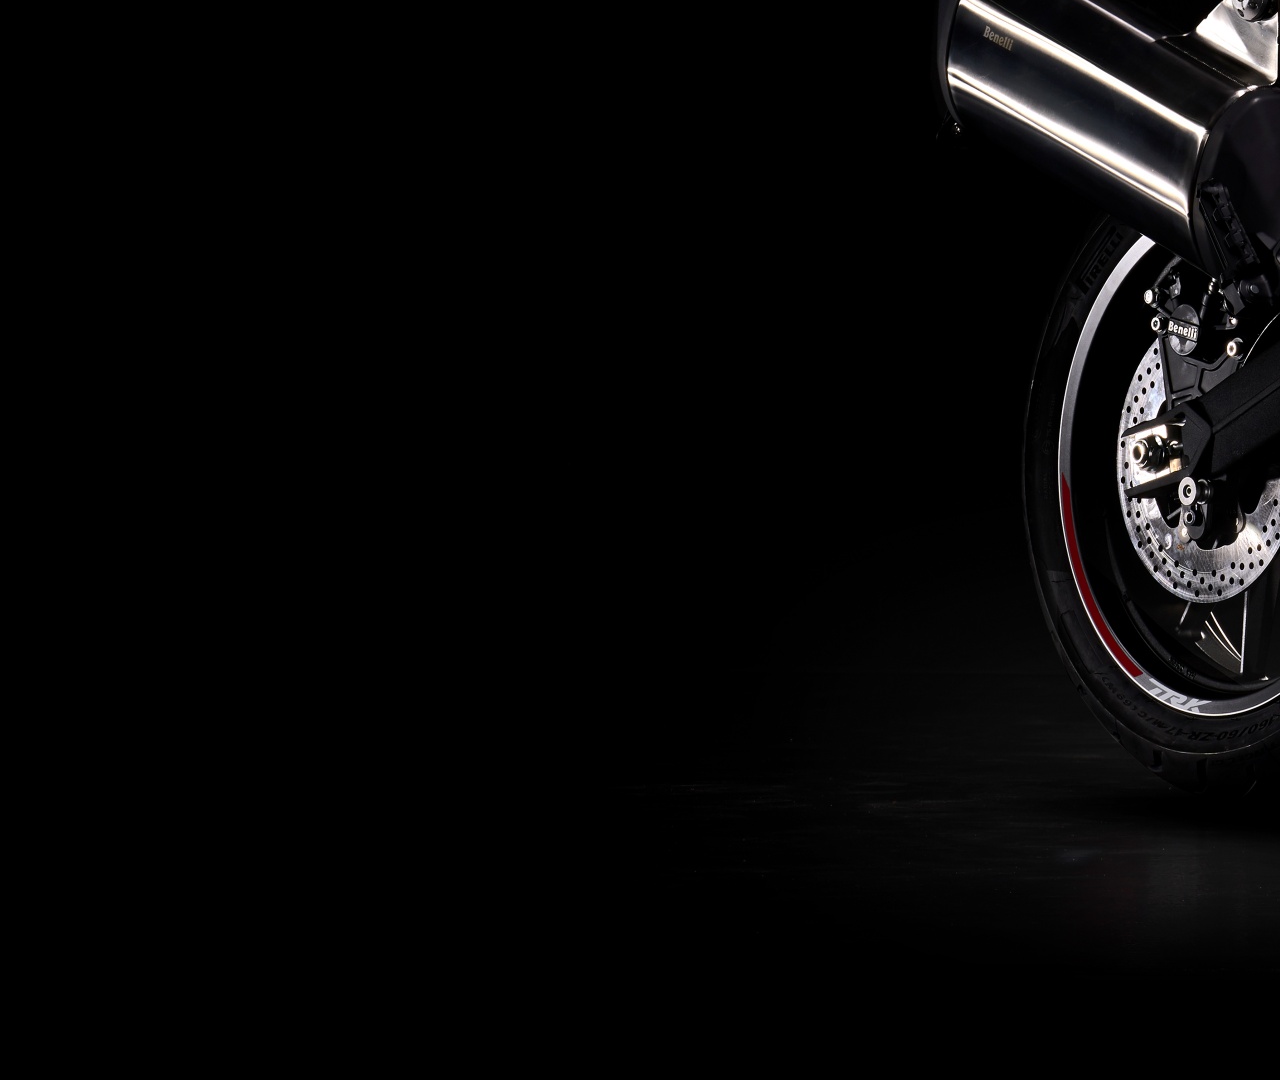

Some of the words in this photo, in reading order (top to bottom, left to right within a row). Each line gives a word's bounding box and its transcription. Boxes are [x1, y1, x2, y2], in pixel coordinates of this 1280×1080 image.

[983, 25, 1014, 51] Benelli
[1074, 225, 1124, 295] PIRELLI
[1167, 319, 1199, 340] Benelli
[1149, 678, 1213, 714] TRK
